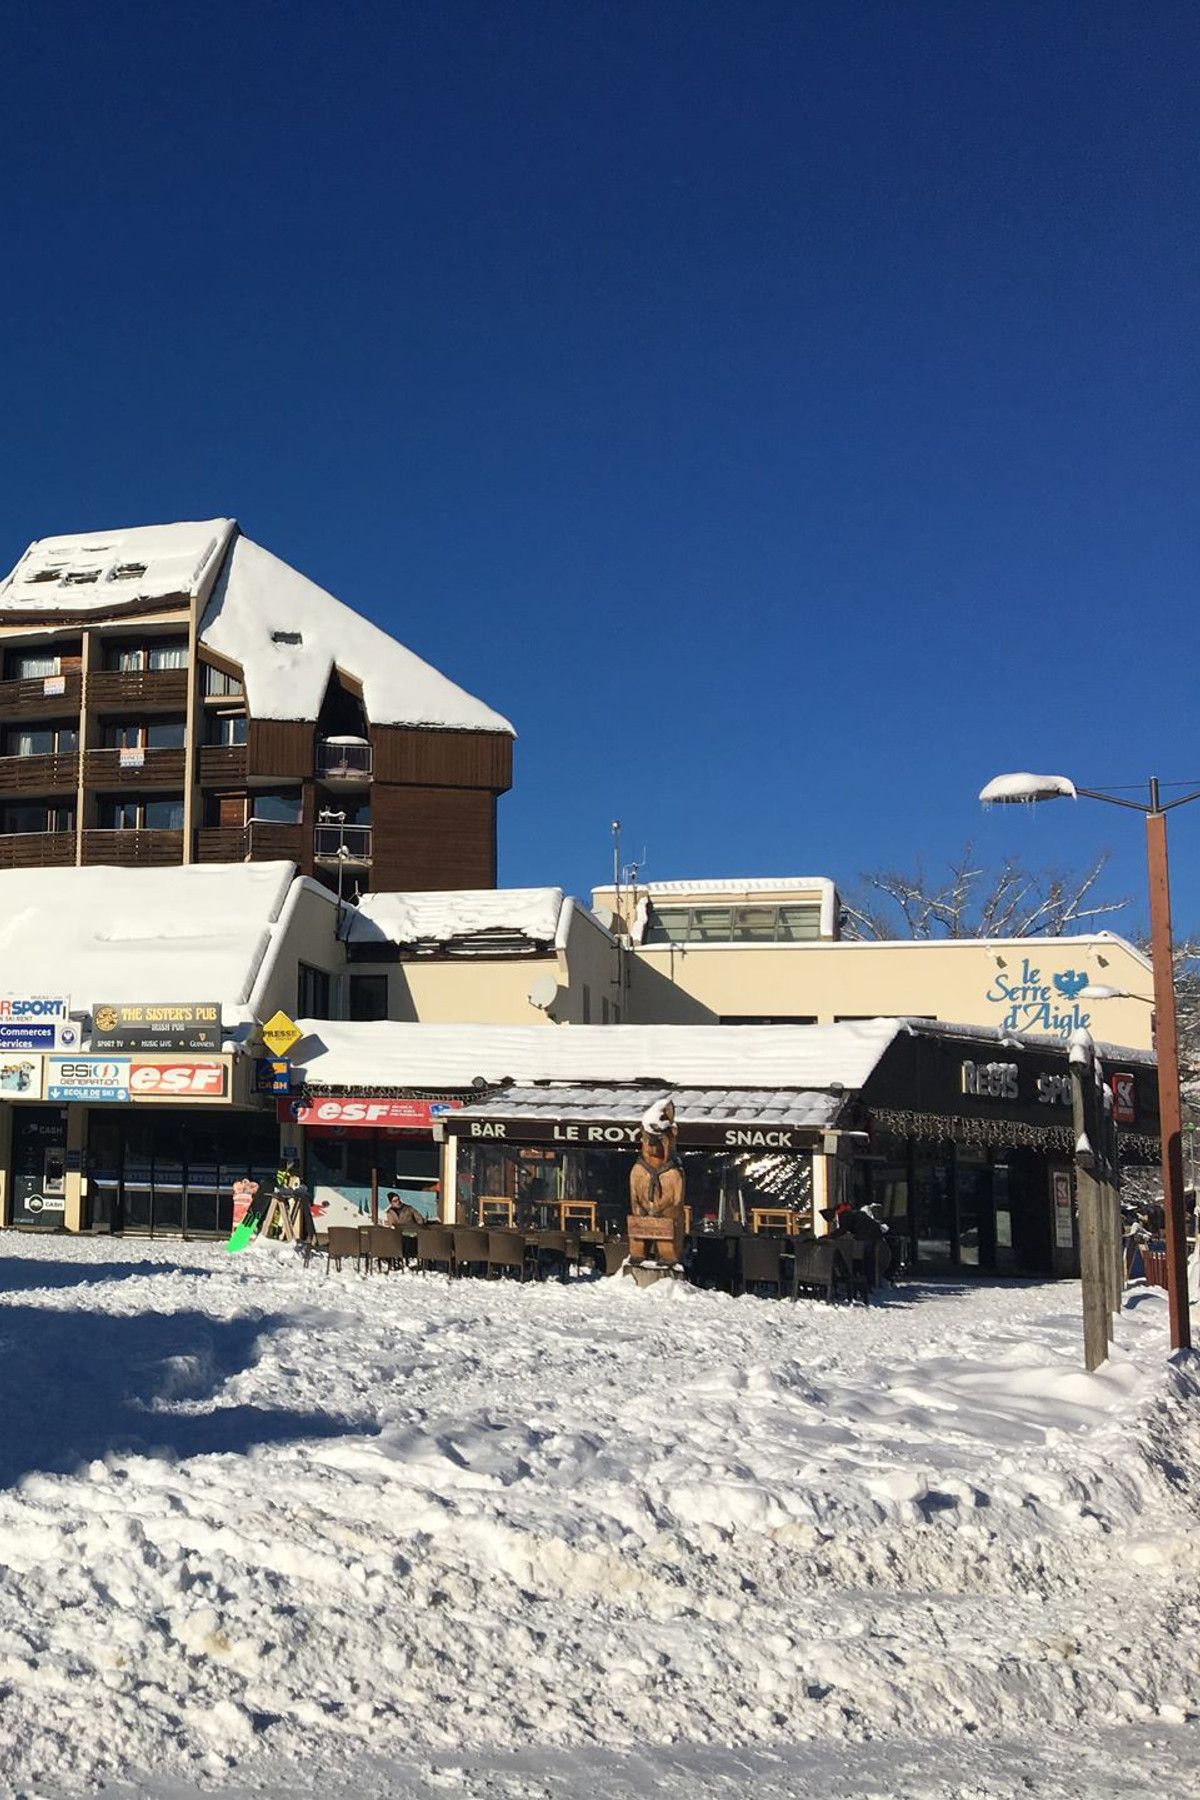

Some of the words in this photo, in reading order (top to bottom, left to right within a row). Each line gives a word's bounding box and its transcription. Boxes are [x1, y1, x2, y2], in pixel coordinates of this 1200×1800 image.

[1022, 958, 1041, 984] le
[986, 974, 1051, 1002] Serre
[121, 1007, 143, 1021] THE
[146, 1007, 193, 1021] SISTER'S
[196, 1007, 218, 1021] PUB
[1003, 1002, 1091, 1039] d'Aigle
[0, 1027, 52, 1037] Commerces
[262, 1030, 297, 1038] PRESSE
[61, 1064, 92, 1078] esi
[961, 1060, 1020, 1099] REGIS
[471, 1123, 506, 1138] BAR
[553, 1125, 579, 1141] LE
[725, 1130, 792, 1147] SNACK
